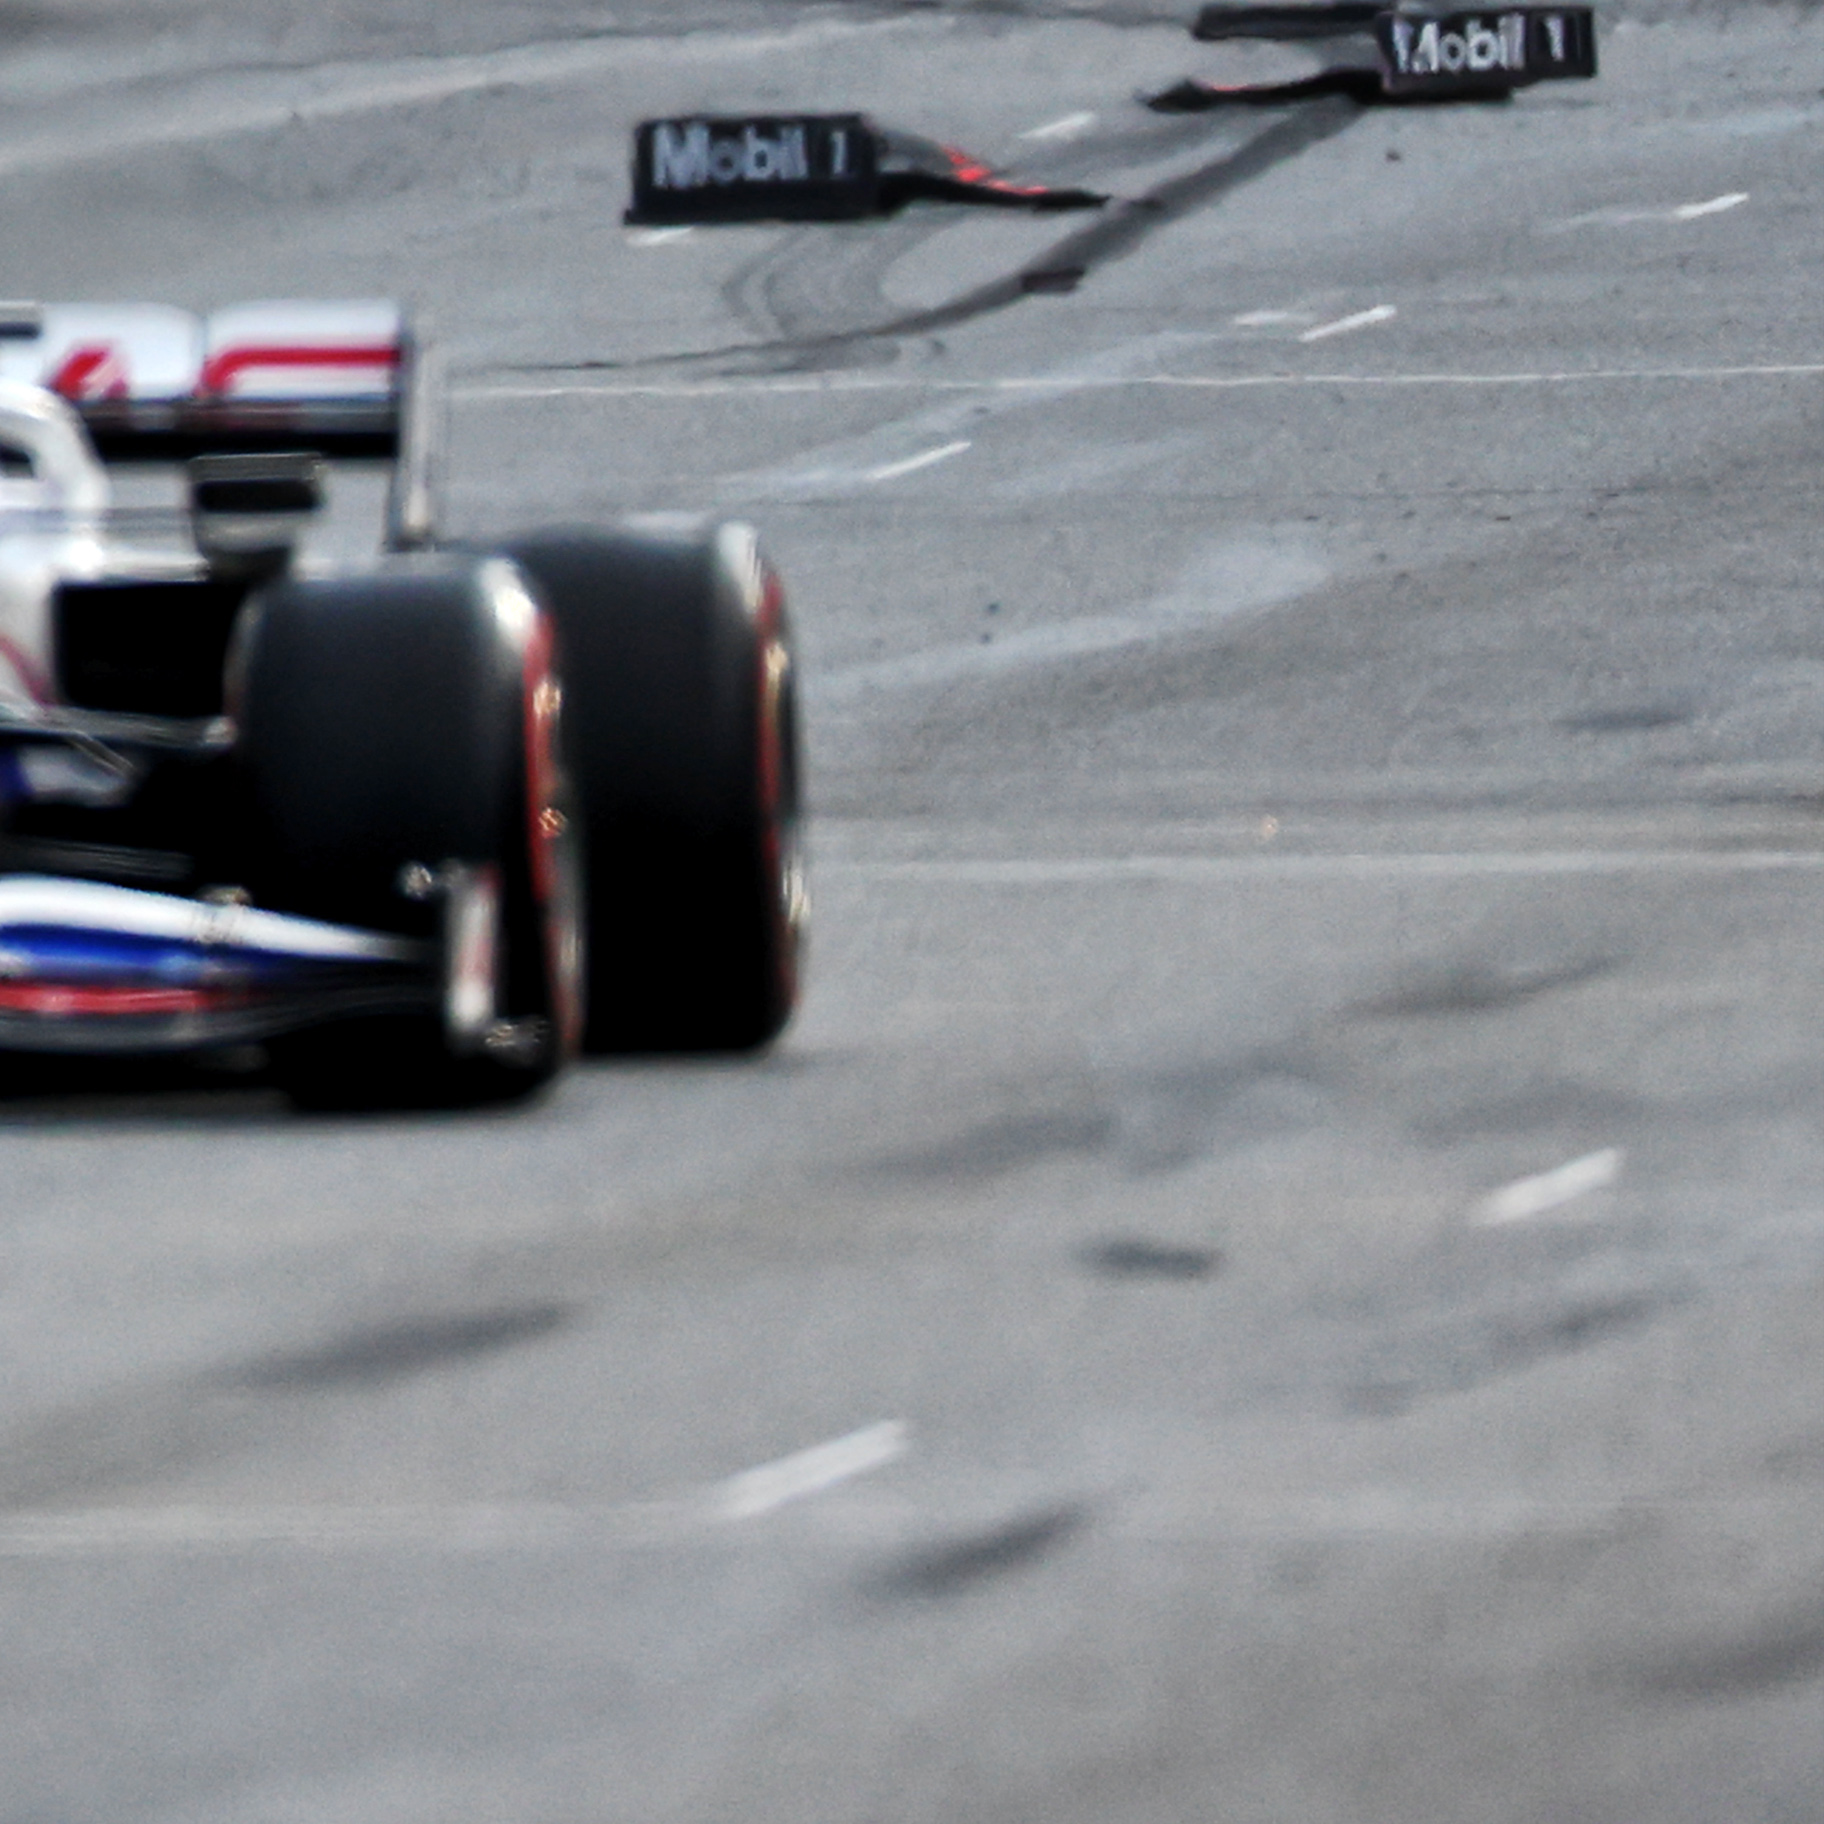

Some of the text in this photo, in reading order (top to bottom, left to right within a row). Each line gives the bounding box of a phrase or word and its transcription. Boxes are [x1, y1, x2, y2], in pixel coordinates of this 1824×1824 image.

[1393, 13, 1564, 74] Mobil 1
[652, 124, 847, 189] Mobil 1
